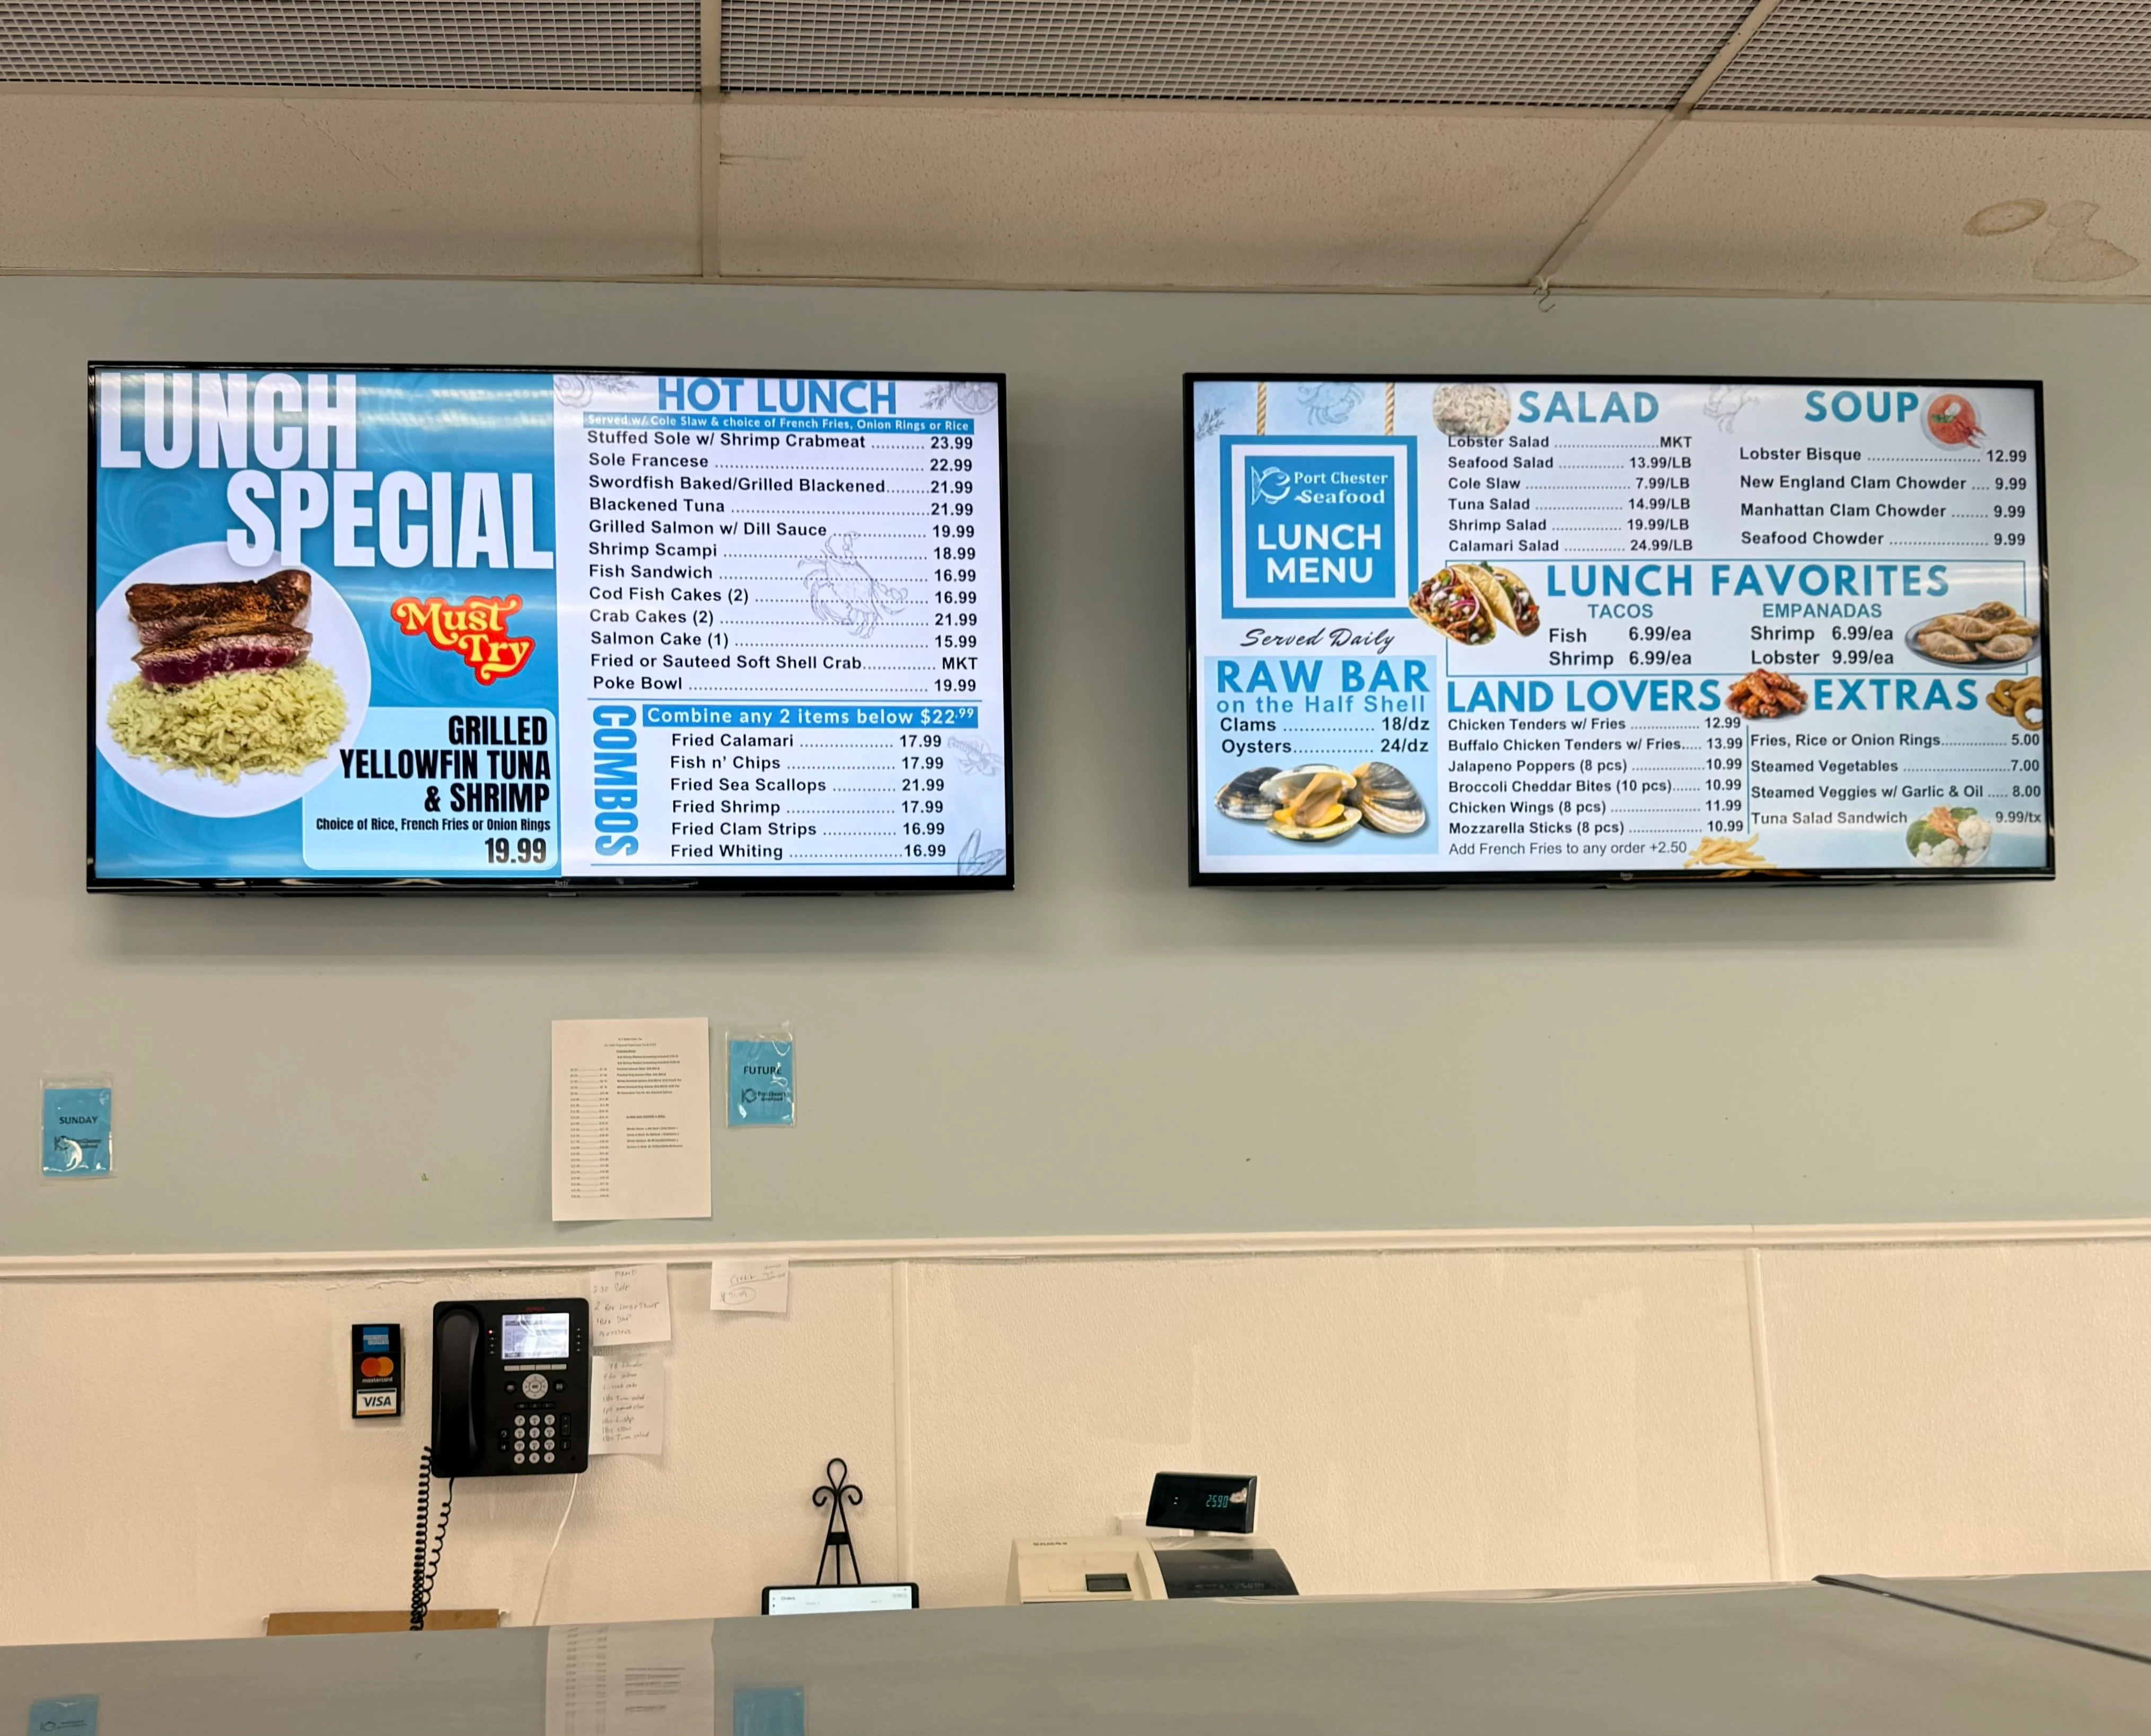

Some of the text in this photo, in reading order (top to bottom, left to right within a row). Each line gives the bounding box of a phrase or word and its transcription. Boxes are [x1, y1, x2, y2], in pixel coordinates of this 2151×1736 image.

[658, 378, 896, 414] HOT LUNCH
[1517, 390, 1658, 424] SALAD
[1804, 390, 1919, 424] SOUP
[100, 372, 356, 470] LUNCH
[589, 414, 627, 425] Served
[631, 416, 646, 426] w/
[650, 416, 675, 427] Cole
[681, 416, 706, 426] Slaw
[711, 417, 718, 426] &
[723, 417, 760, 427] choice
[765, 418, 775, 427] of
[780, 418, 818, 428] French
[823, 419, 853, 429] Fries,
[857, 419, 891, 429] Onion
[895, 420, 925, 431] Rings
[945, 420, 968, 430] Rice
[588, 431, 972, 450] Stuffed Sole w/ Shrimp Crabmeat 23.99
[1448, 457, 1691, 468] Seafood Salad 13.99/LB
[1740, 448, 2026, 463] Lobster Bisque 12.99
[1295, 472, 1388, 484] Port Chester
[1448, 477, 1689, 489] Cole Slaw 7.99/LB
[1741, 475, 2026, 491] New England Clam Chowder 9.99
[1294, 489, 1384, 503] Seafood
[226, 470, 554, 568] SPECIAL
[590, 520, 974, 538] Grilled Salmon w/ Dill Sauce 19.99
[1258, 524, 1380, 550] LUNCH
[590, 542, 975, 560] Shrimp Scampi 18.99
[590, 564, 976, 582] Fish Sandwich 16.99
[1268, 558, 1372, 583] MENU
[1547, 564, 1950, 598] LUNCH FAVORITES
[590, 586, 976, 605] Cod Fish Cakes (2) 16.99
[1588, 604, 1653, 618] TACOS
[1763, 603, 1882, 618] EMPANADAS
[397, 600, 517, 645] Must
[592, 632, 976, 649] Salmon Cake (1) 15.99
[1240, 628, 1396, 654] Served Daily
[1550, 626, 1691, 643] Fish 6.99/ea
[1751, 626, 1893, 644] Shrimp 6.99/ea
[459, 634, 530, 680] Try
[1550, 651, 1691, 669] Shrimp 6.99/ea
[1752, 650, 1893, 664] Lobster 9.99/ea
[594, 676, 976, 691] Poke Bowl 19.99
[1217, 658, 1429, 694] RAW BAR
[1447, 679, 1721, 713] LAND LOVERS
[1814, 678, 1978, 711] EXTRAS
[1217, 695, 1424, 713] on the Half Shell
[648, 707, 732, 723] Combine
[740, 712, 772, 726] any
[780, 708, 789, 723] 2
[798, 708, 849, 723] items
[857, 708, 912, 724] below
[1221, 717, 1429, 731] Clams 18/dz
[1448, 717, 1741, 730] Chicken Tenders w/ Fries 12.99
[449, 715, 547, 745] GRILLED
[673, 734, 941, 747] Fried Calamari 17.99
[340, 749, 550, 779] YELLOWFIN TUNA
[671, 756, 705, 768] Fish
[733, 756, 780, 771] Chips
[902, 757, 943, 769] 17.99
[1751, 760, 1813, 772] Steamed
[1819, 760, 1898, 775] Vegetables
[593, 705, 638, 856] COMBOS
[425, 783, 549, 812] & SHRIMP
[1449, 800, 1741, 816] Chicken Wings (8 pcs) 11.99
[317, 818, 550, 832] Choice of Rice, French Fries or Onion Rings
[485, 838, 546, 863] 19.99
[1449, 841, 1687, 856] Add French Fries to any order +2.50
[363, 1396, 391, 1407] VISA
